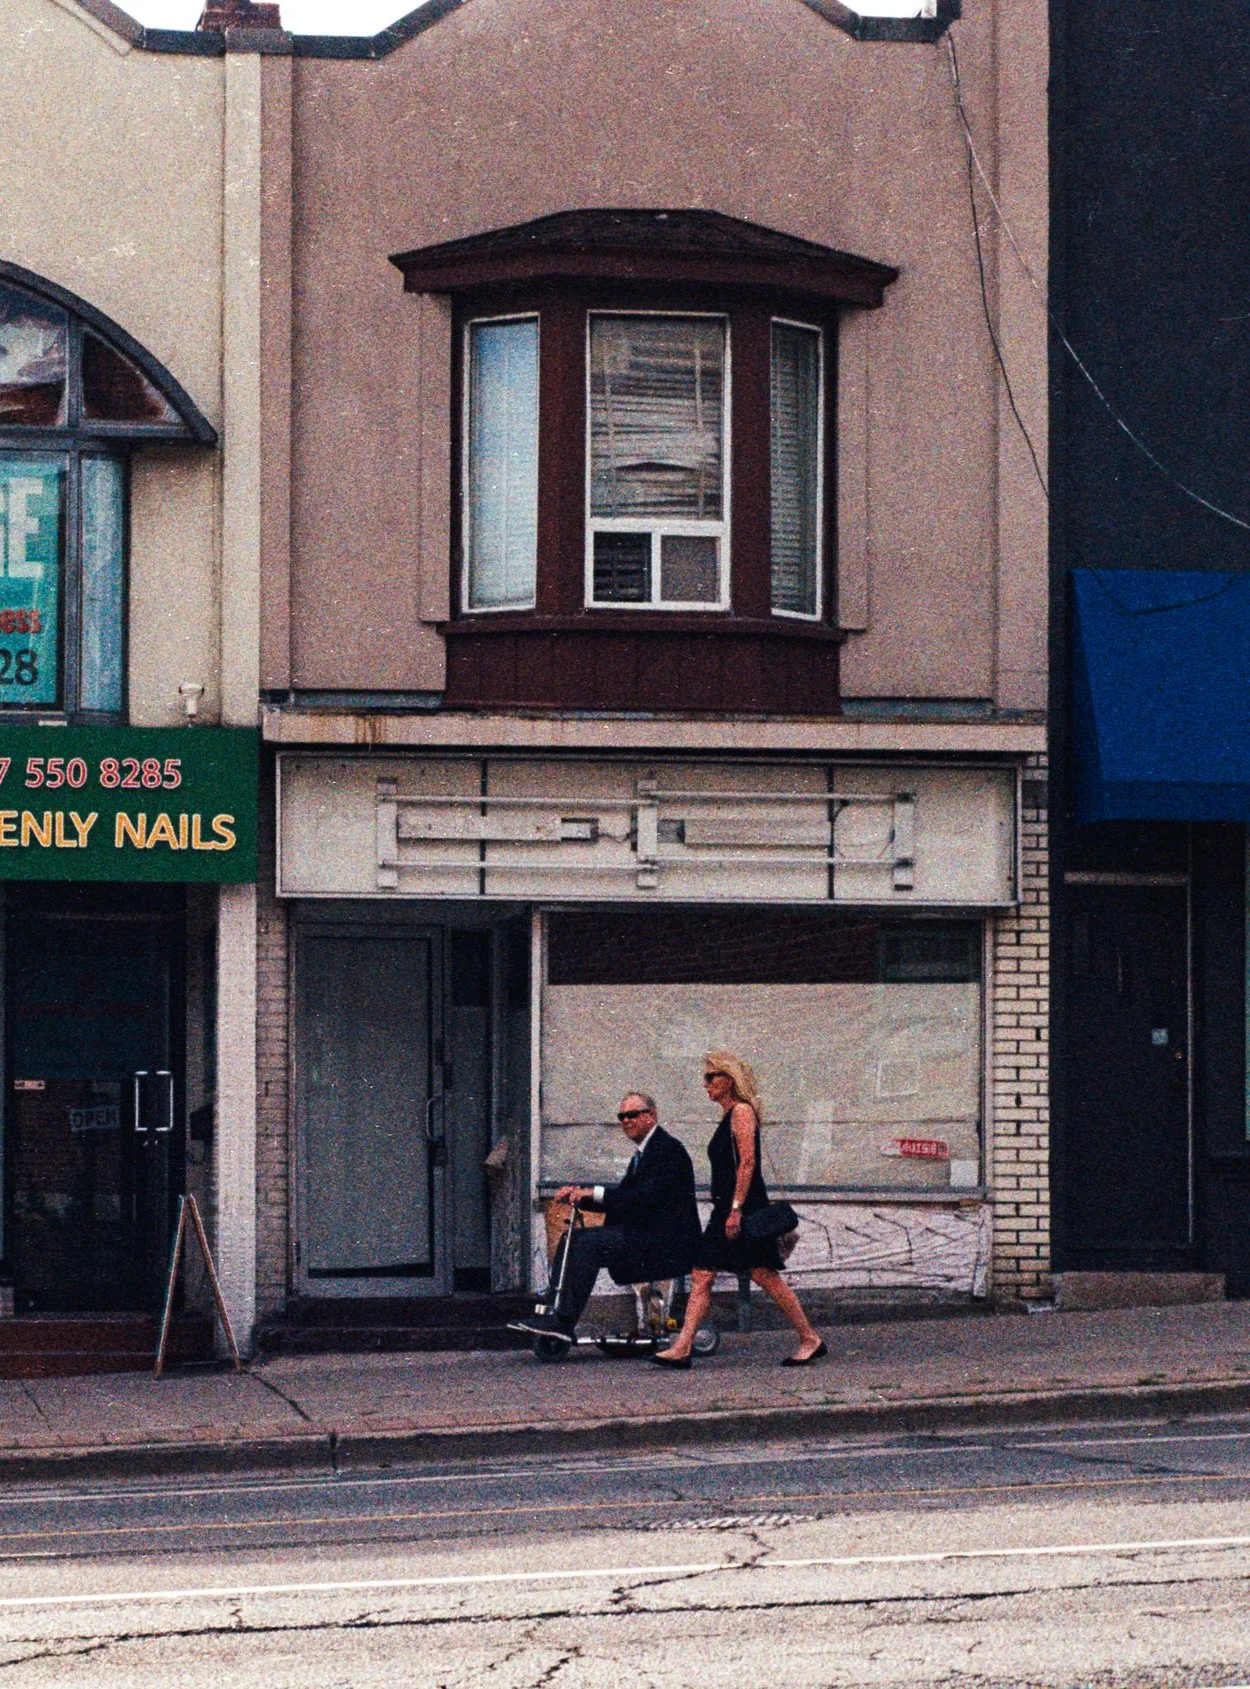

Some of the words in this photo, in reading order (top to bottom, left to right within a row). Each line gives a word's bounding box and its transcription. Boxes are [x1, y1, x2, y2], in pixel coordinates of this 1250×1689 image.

[25, 758, 88, 788] 550
[100, 758, 182, 789] 8285
[114, 812, 237, 851] NAILS
